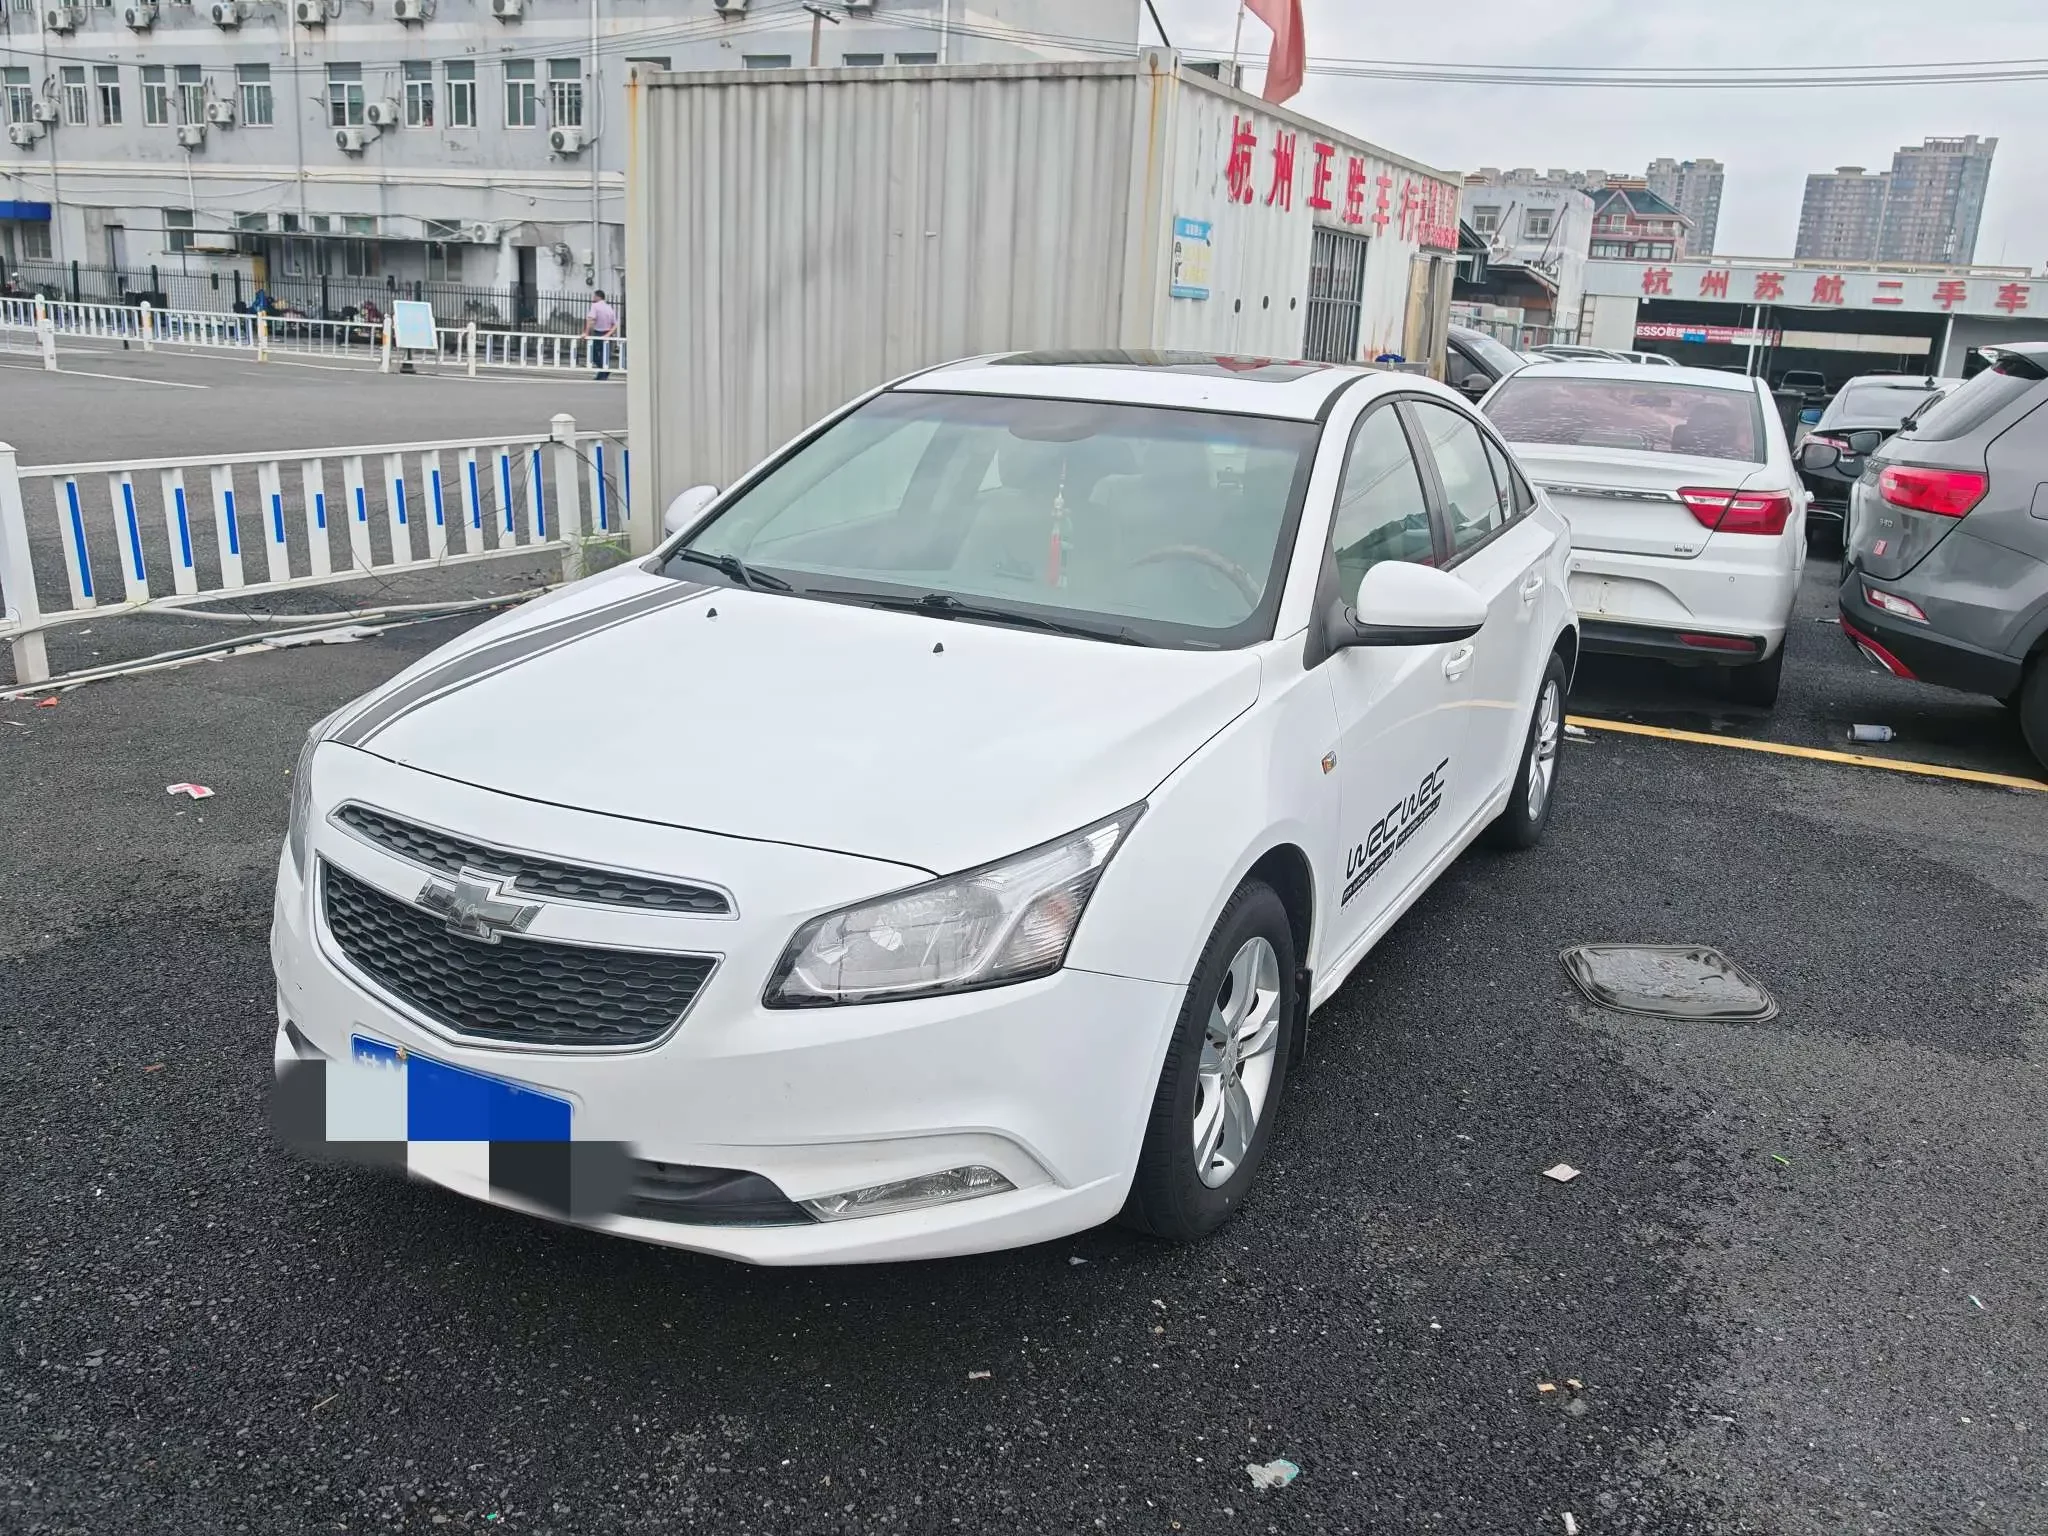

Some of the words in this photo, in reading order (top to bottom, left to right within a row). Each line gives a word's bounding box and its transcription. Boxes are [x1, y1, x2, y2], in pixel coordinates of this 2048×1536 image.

[1642, 265, 2031, 314] 杭州苏航二手车
